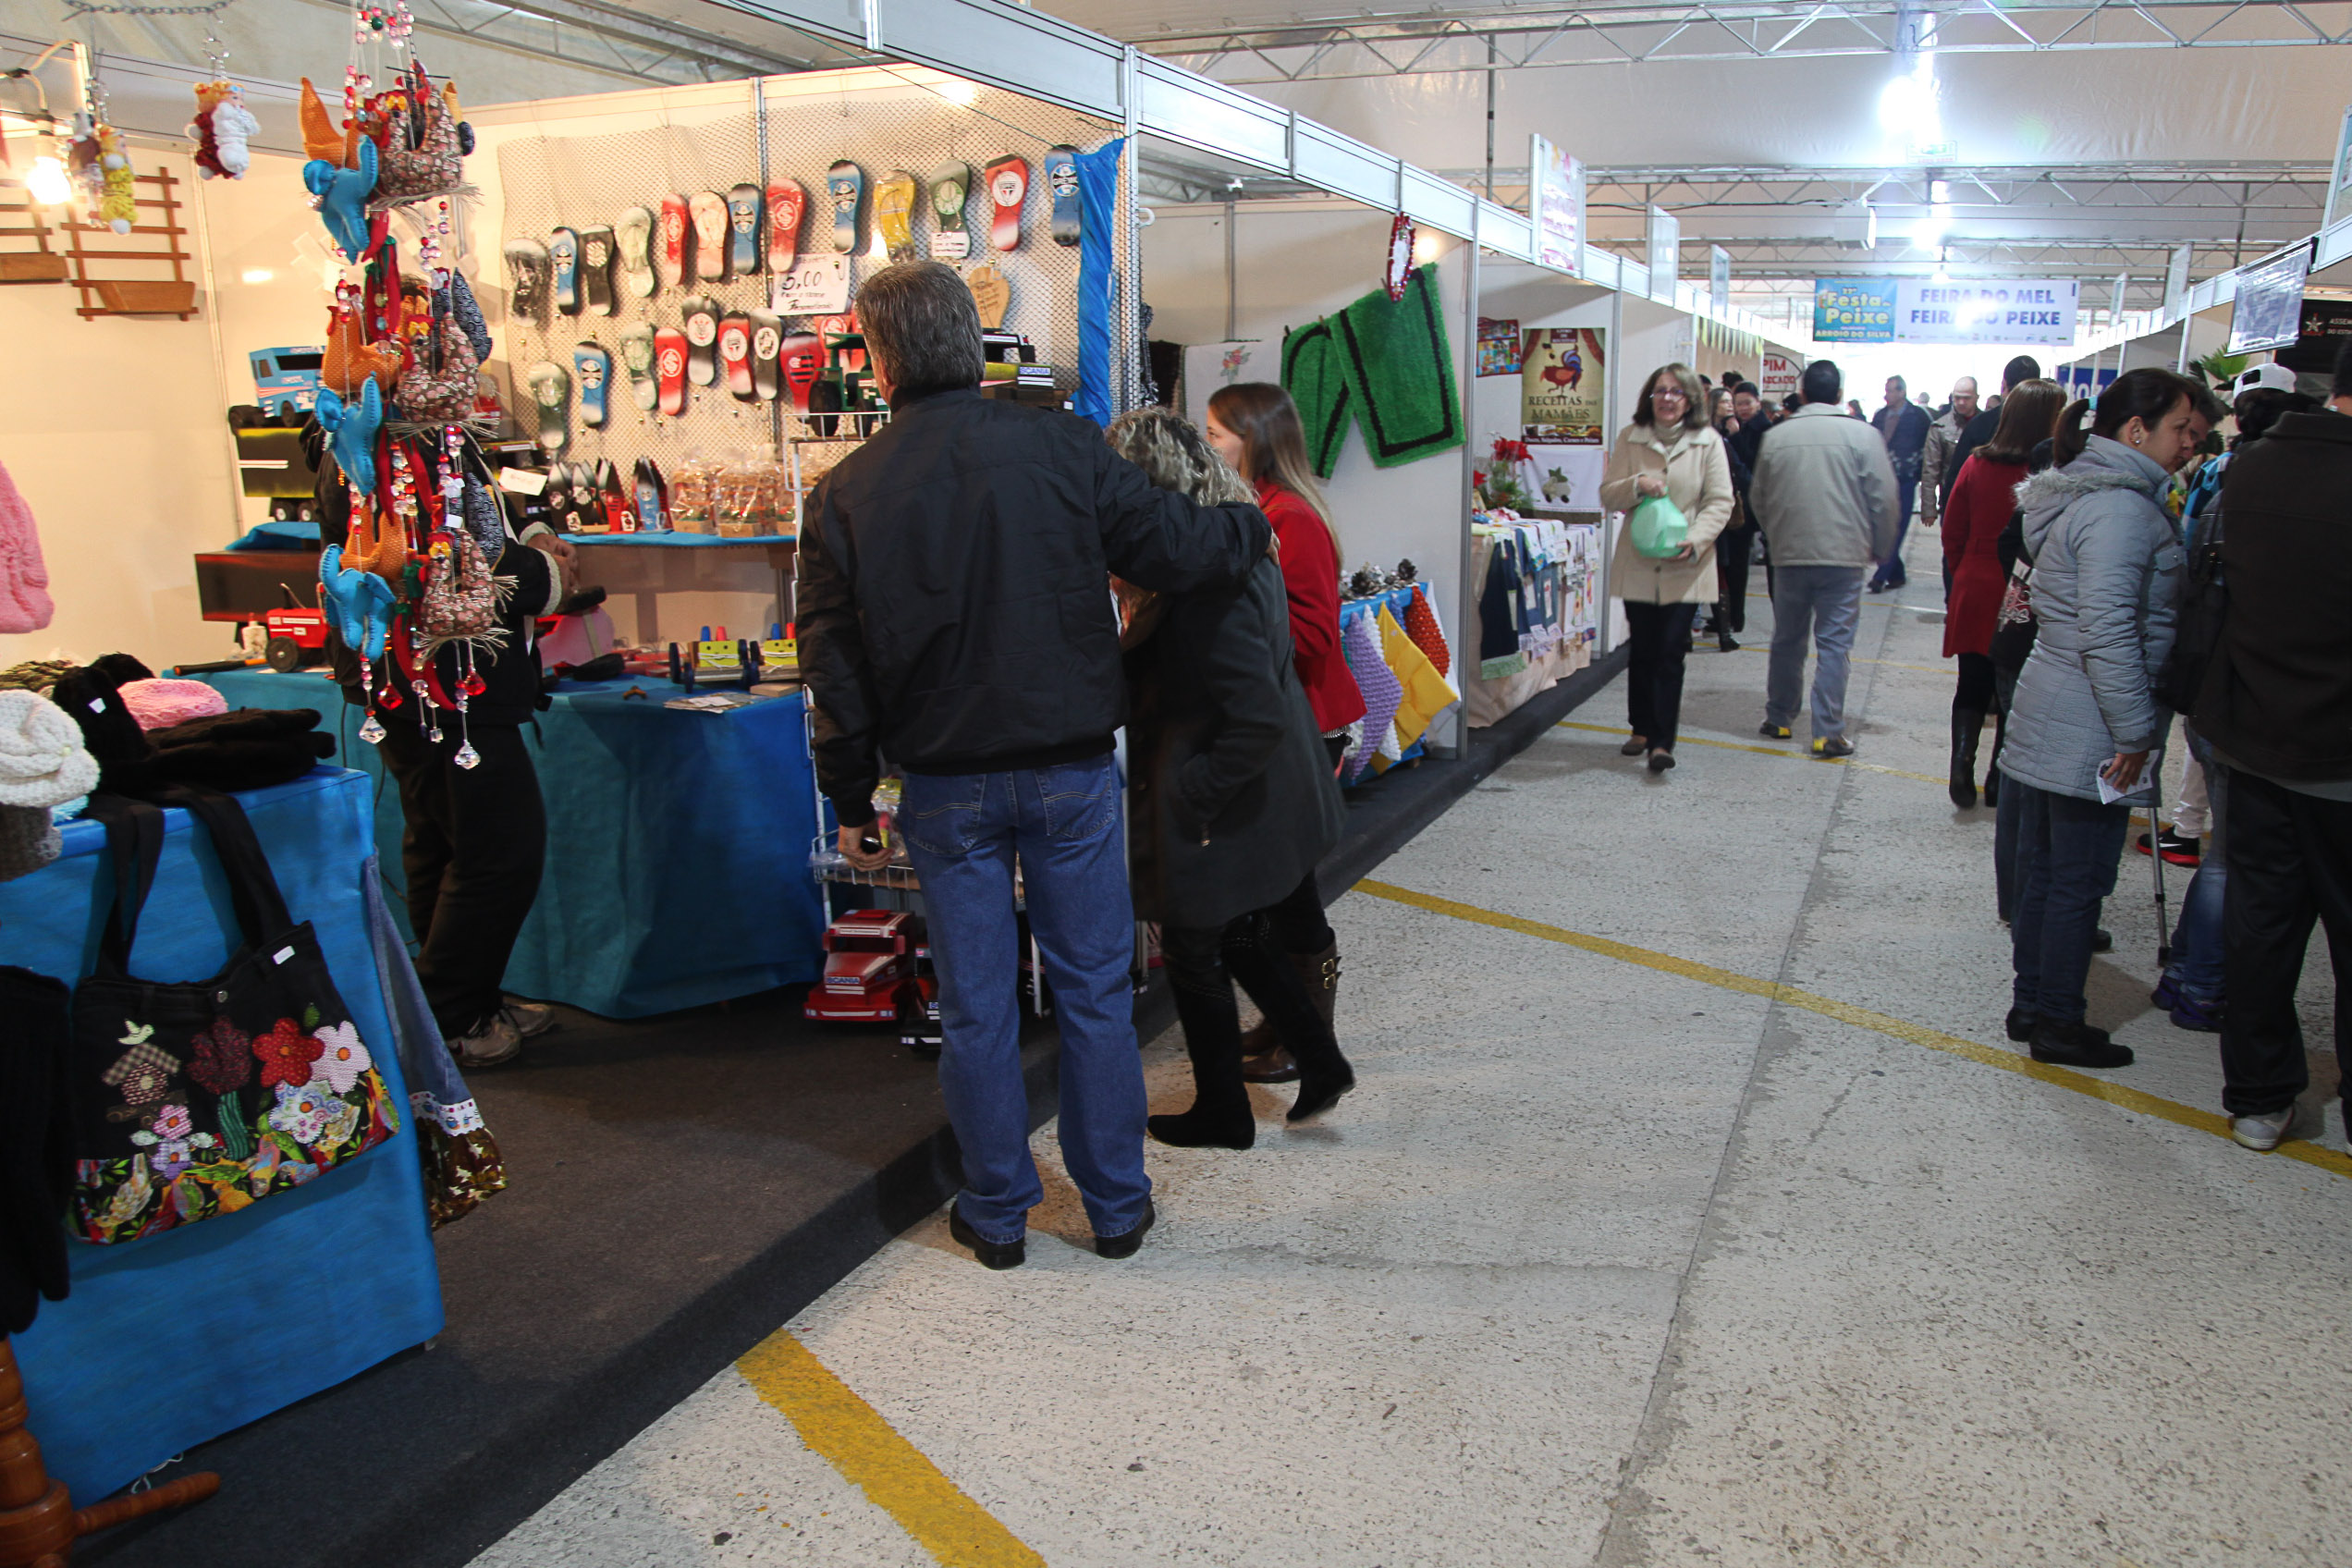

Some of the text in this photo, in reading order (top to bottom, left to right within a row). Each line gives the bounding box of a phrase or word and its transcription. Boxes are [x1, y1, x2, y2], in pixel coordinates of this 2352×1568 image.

[1827, 291, 1882, 306] Festa
[1920, 288, 2056, 304] FEIRA DO MEL
[1825, 307, 1890, 324] Peixe
[1910, 310, 1962, 324] FEIR
[2006, 311, 2061, 325] PEIXE
[1867, 330, 1892, 338] SILVA
[1019, 366, 1050, 375] SCANIA
[1528, 396, 1583, 406] RECEITAS
[1531, 407, 1591, 420] MAMÃES
